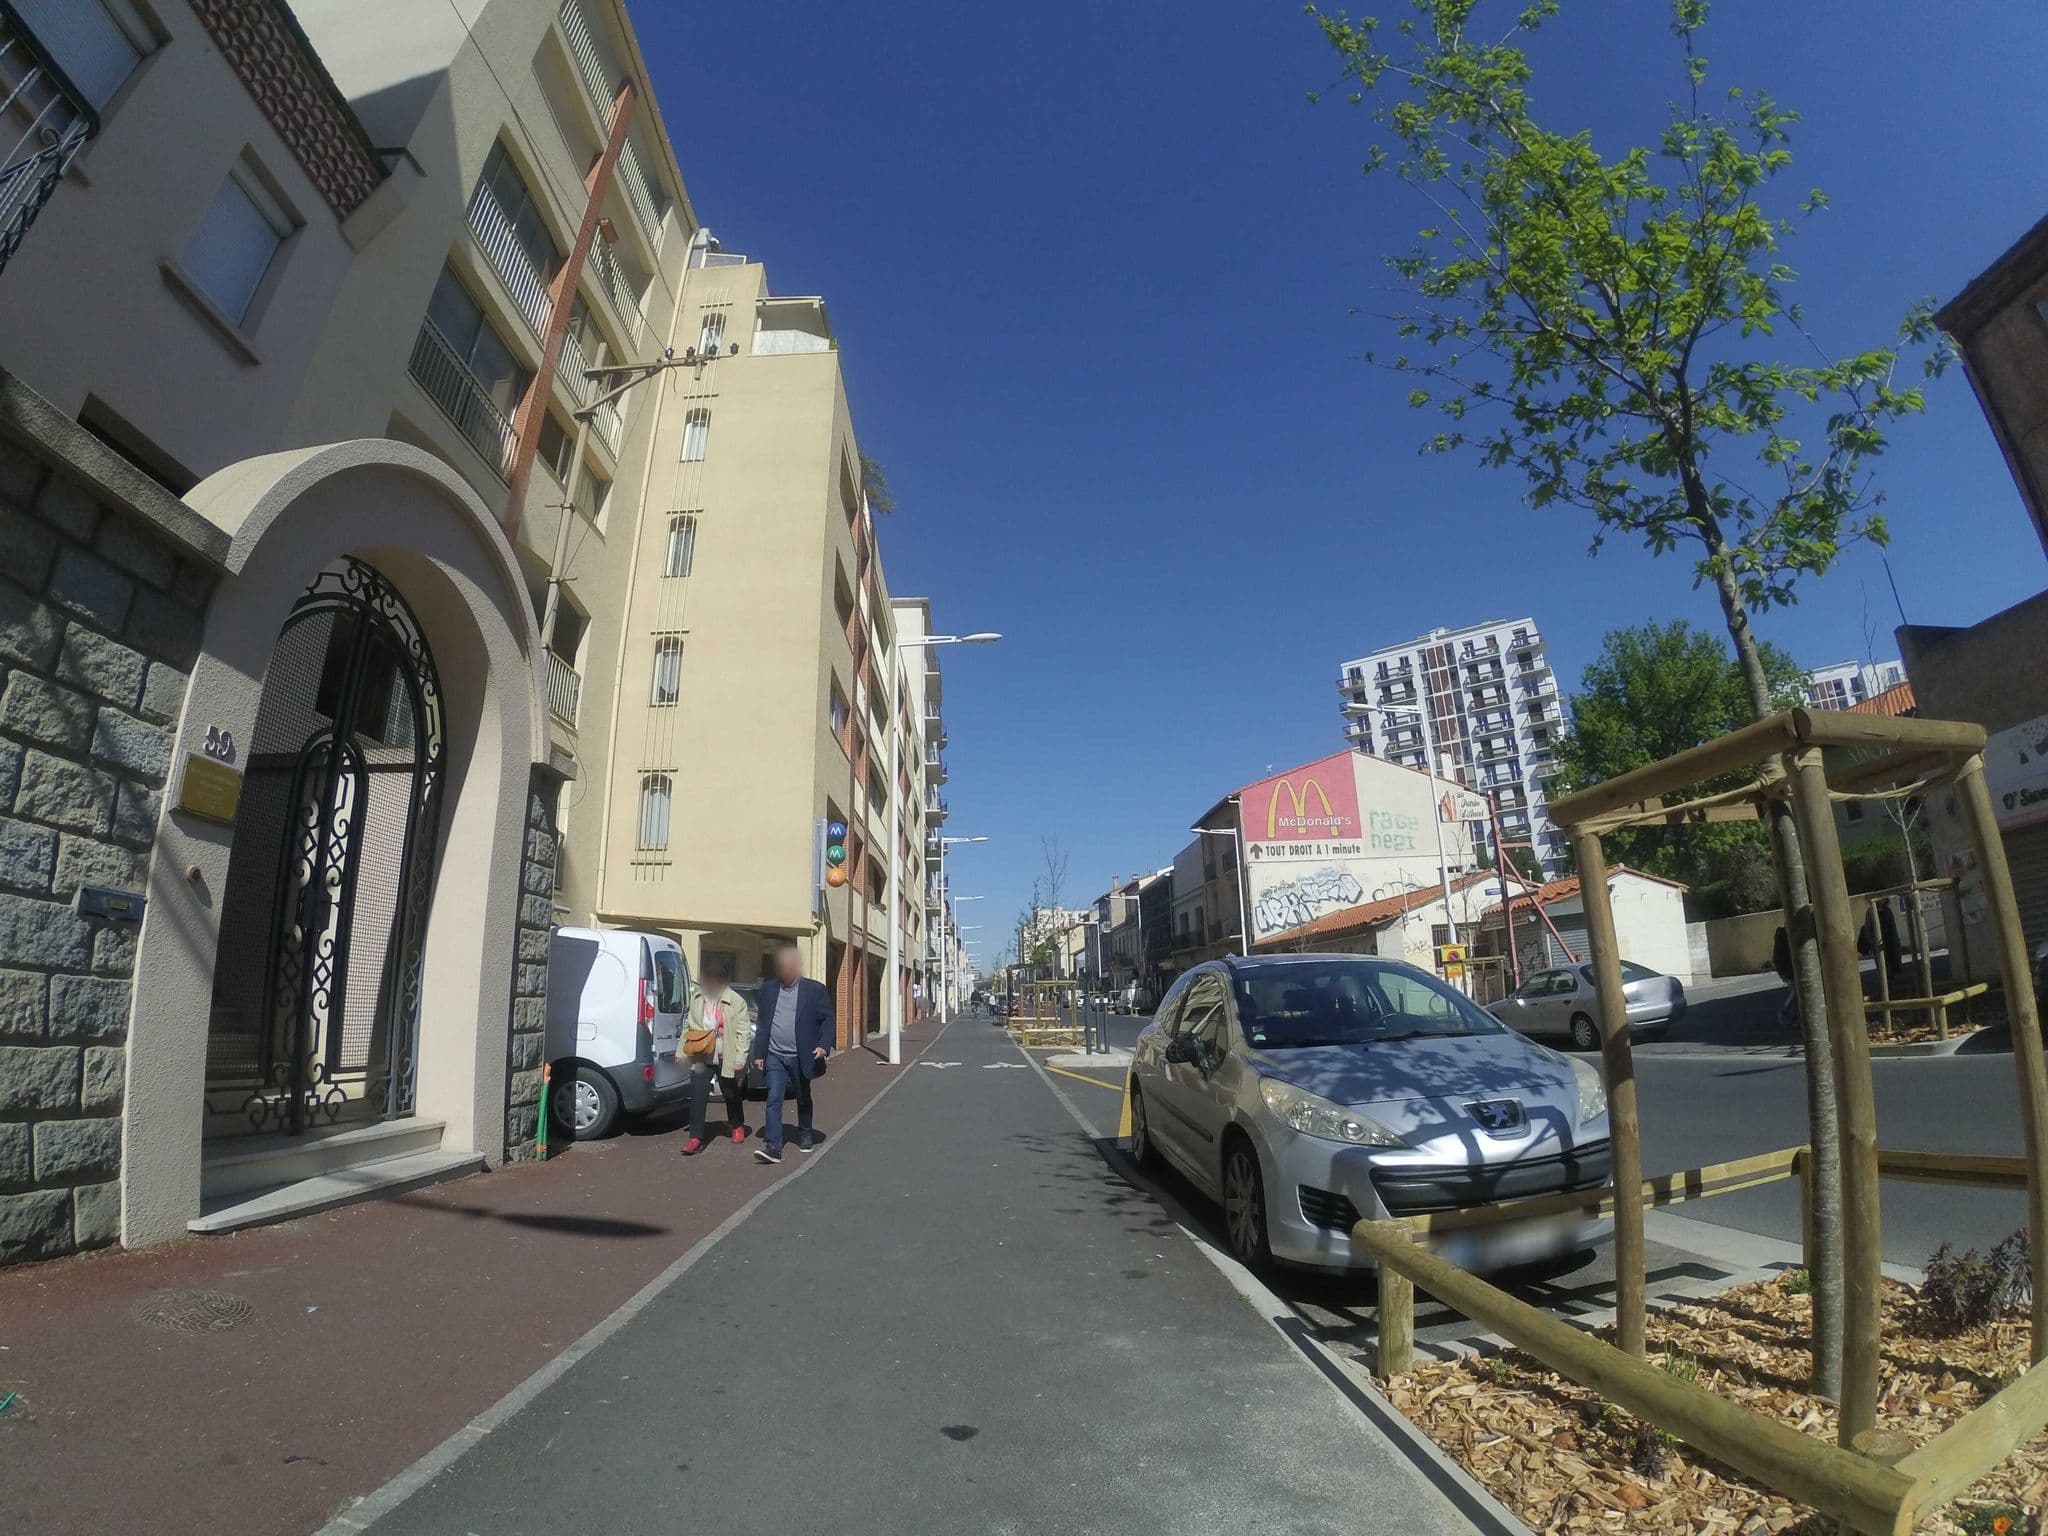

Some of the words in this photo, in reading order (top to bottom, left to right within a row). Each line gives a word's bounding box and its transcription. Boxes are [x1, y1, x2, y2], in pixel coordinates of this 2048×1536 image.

[203, 725, 231, 756] 59
[1278, 816, 1352, 827] McDonald's
[1265, 845, 1286, 857] TOUT
[1289, 844, 1312, 856] DROIT
[1316, 844, 1322, 855] A
[1332, 843, 1361, 855] minute
